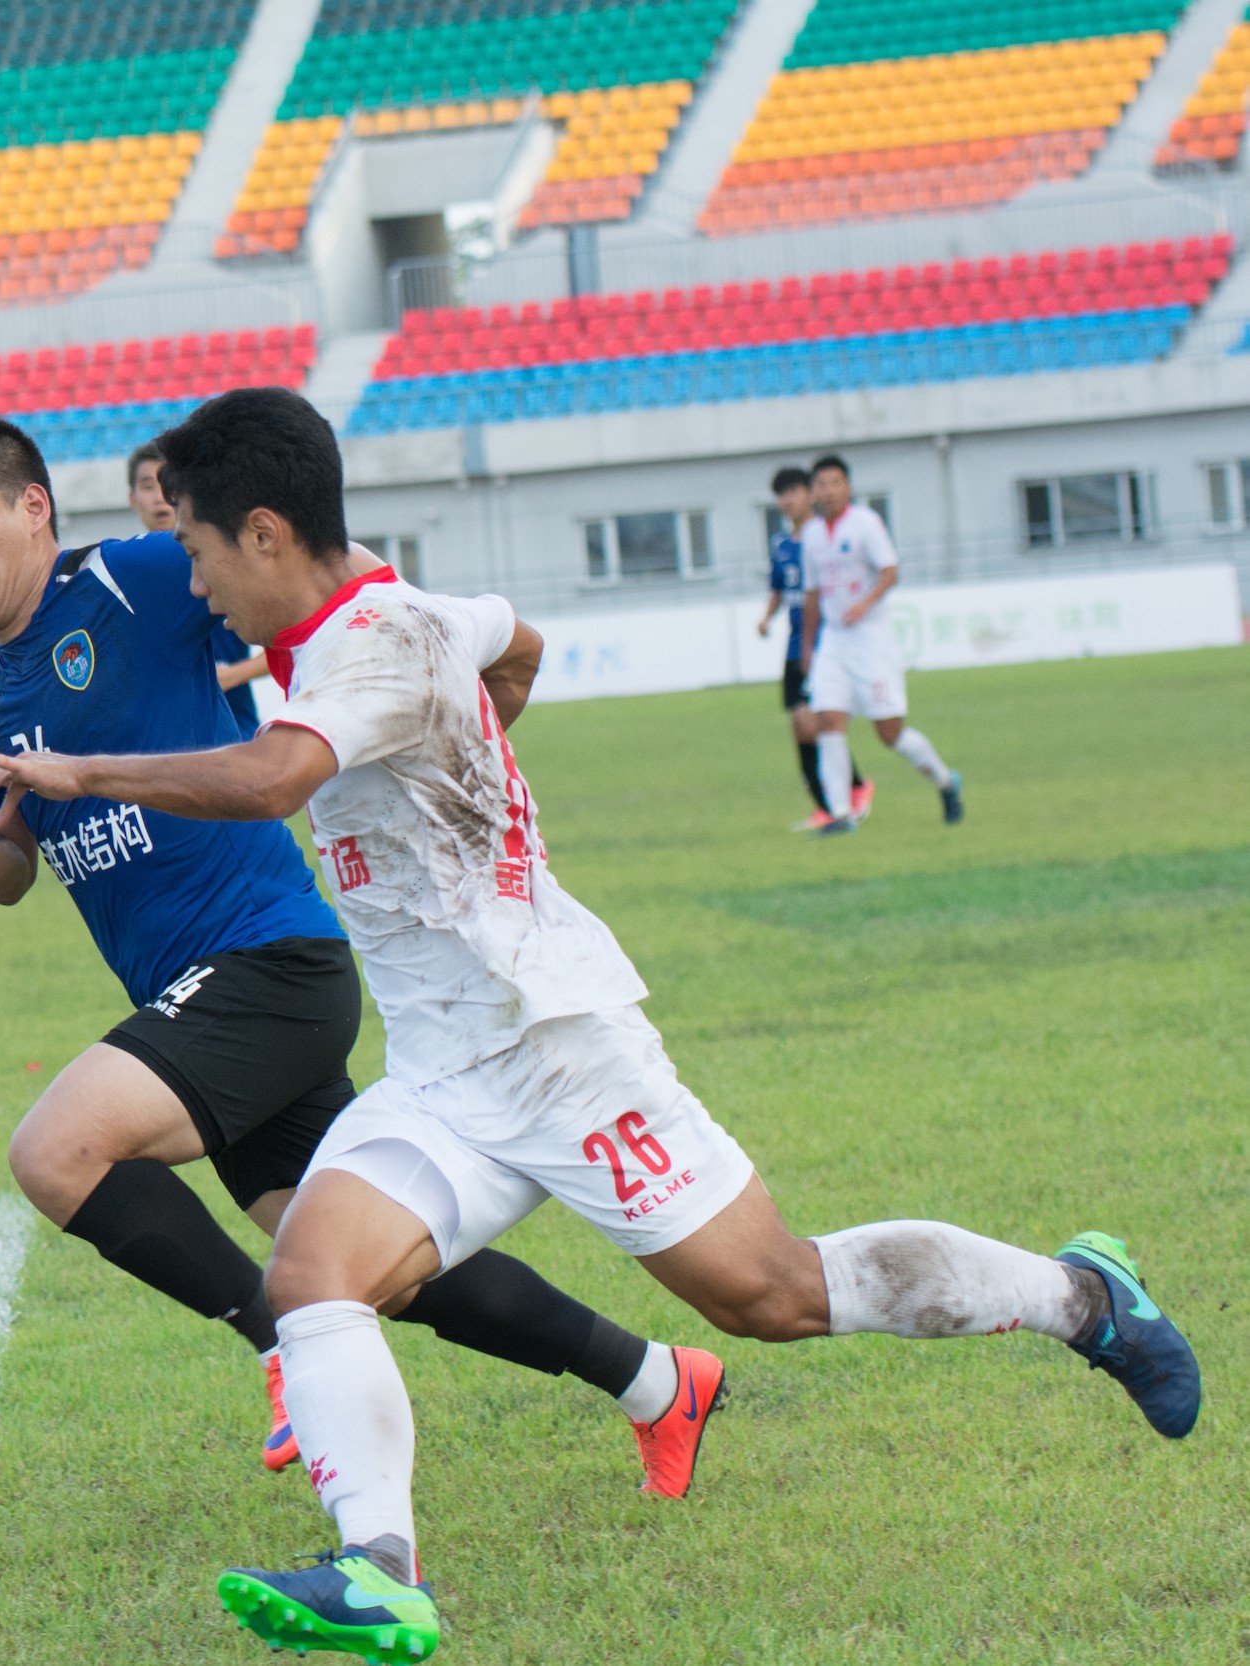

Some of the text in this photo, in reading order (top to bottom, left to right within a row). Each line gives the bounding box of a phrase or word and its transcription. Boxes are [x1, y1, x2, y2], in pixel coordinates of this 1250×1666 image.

[318, 835, 372, 893] 场
[158, 965, 215, 1005] 4
[582, 1111, 672, 1204] 26
[623, 1169, 696, 1222] KELME
